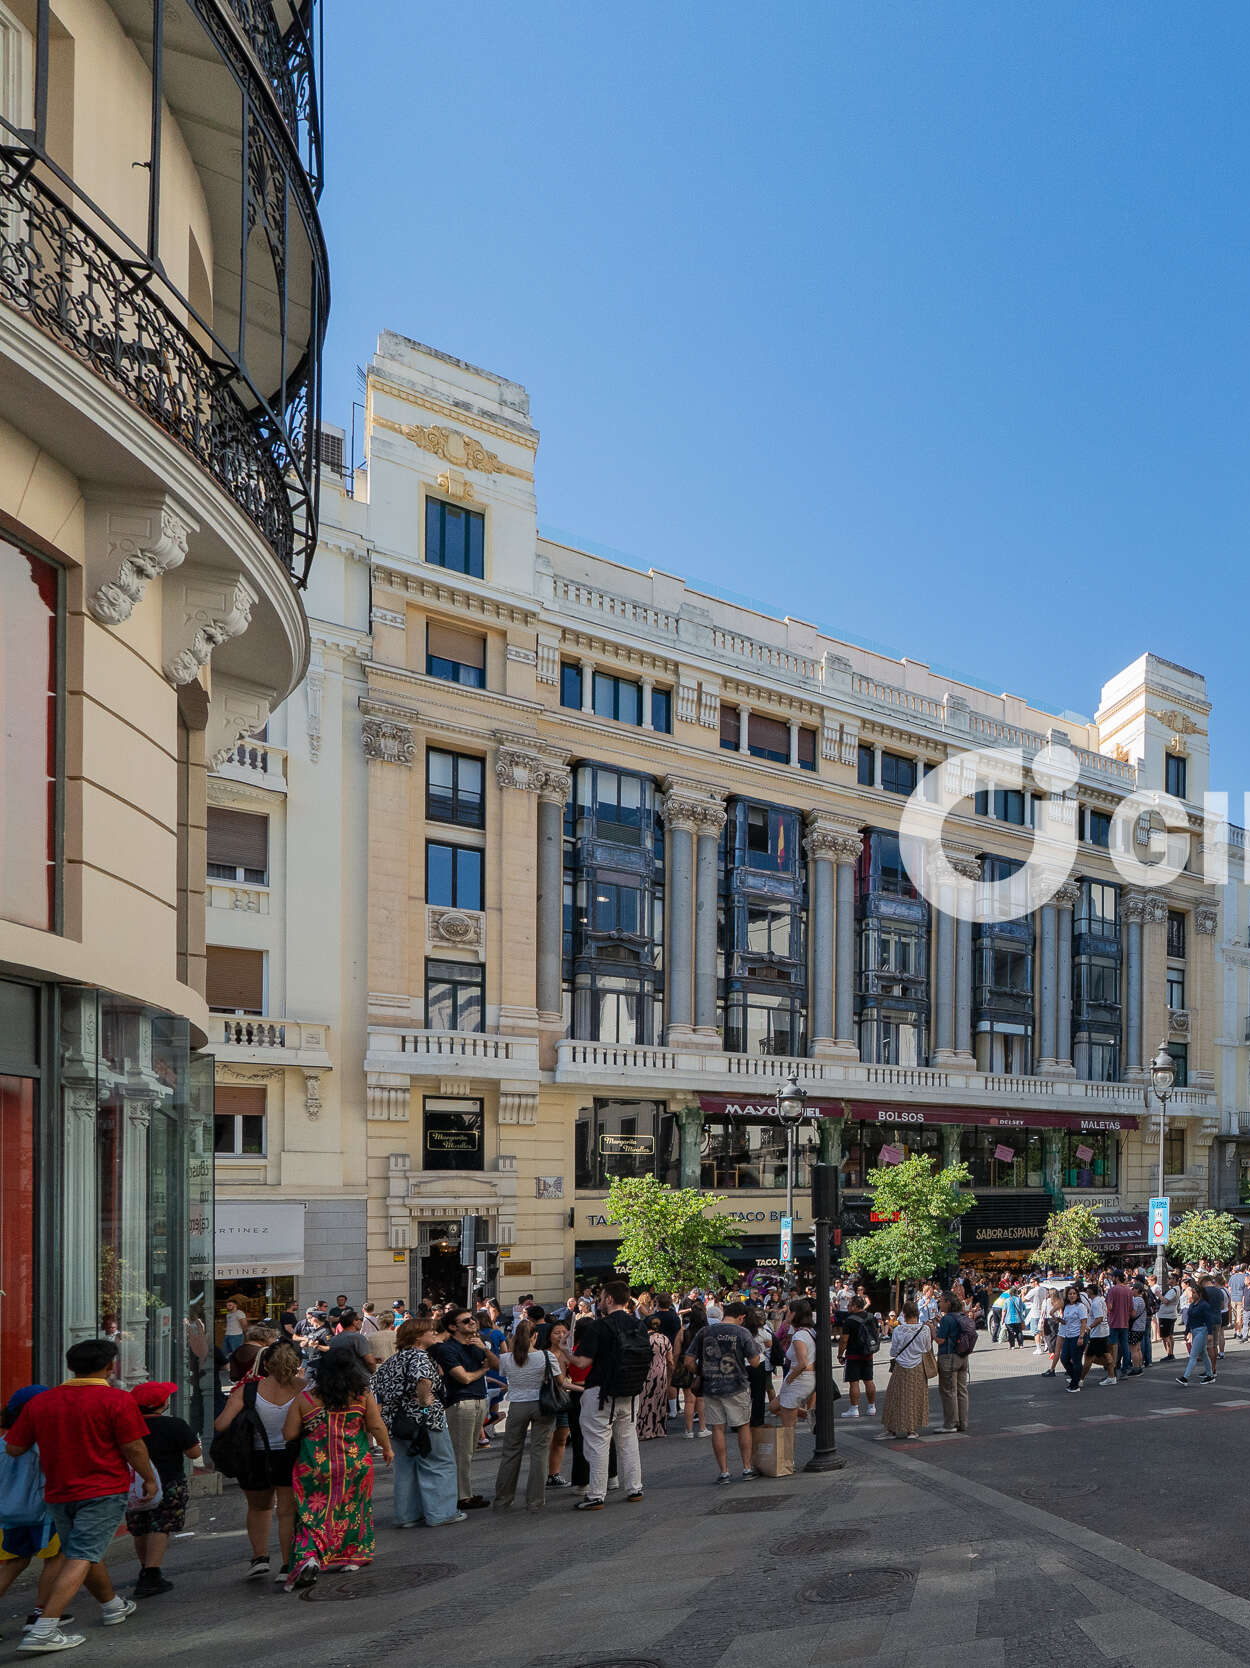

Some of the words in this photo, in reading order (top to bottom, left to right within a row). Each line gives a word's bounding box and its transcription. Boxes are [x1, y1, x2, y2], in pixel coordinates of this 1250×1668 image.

[878, 1111, 925, 1122] BOLSOS
[1080, 1120, 1121, 1130] MALETAS
[755, 1258, 778, 1267] TACO
